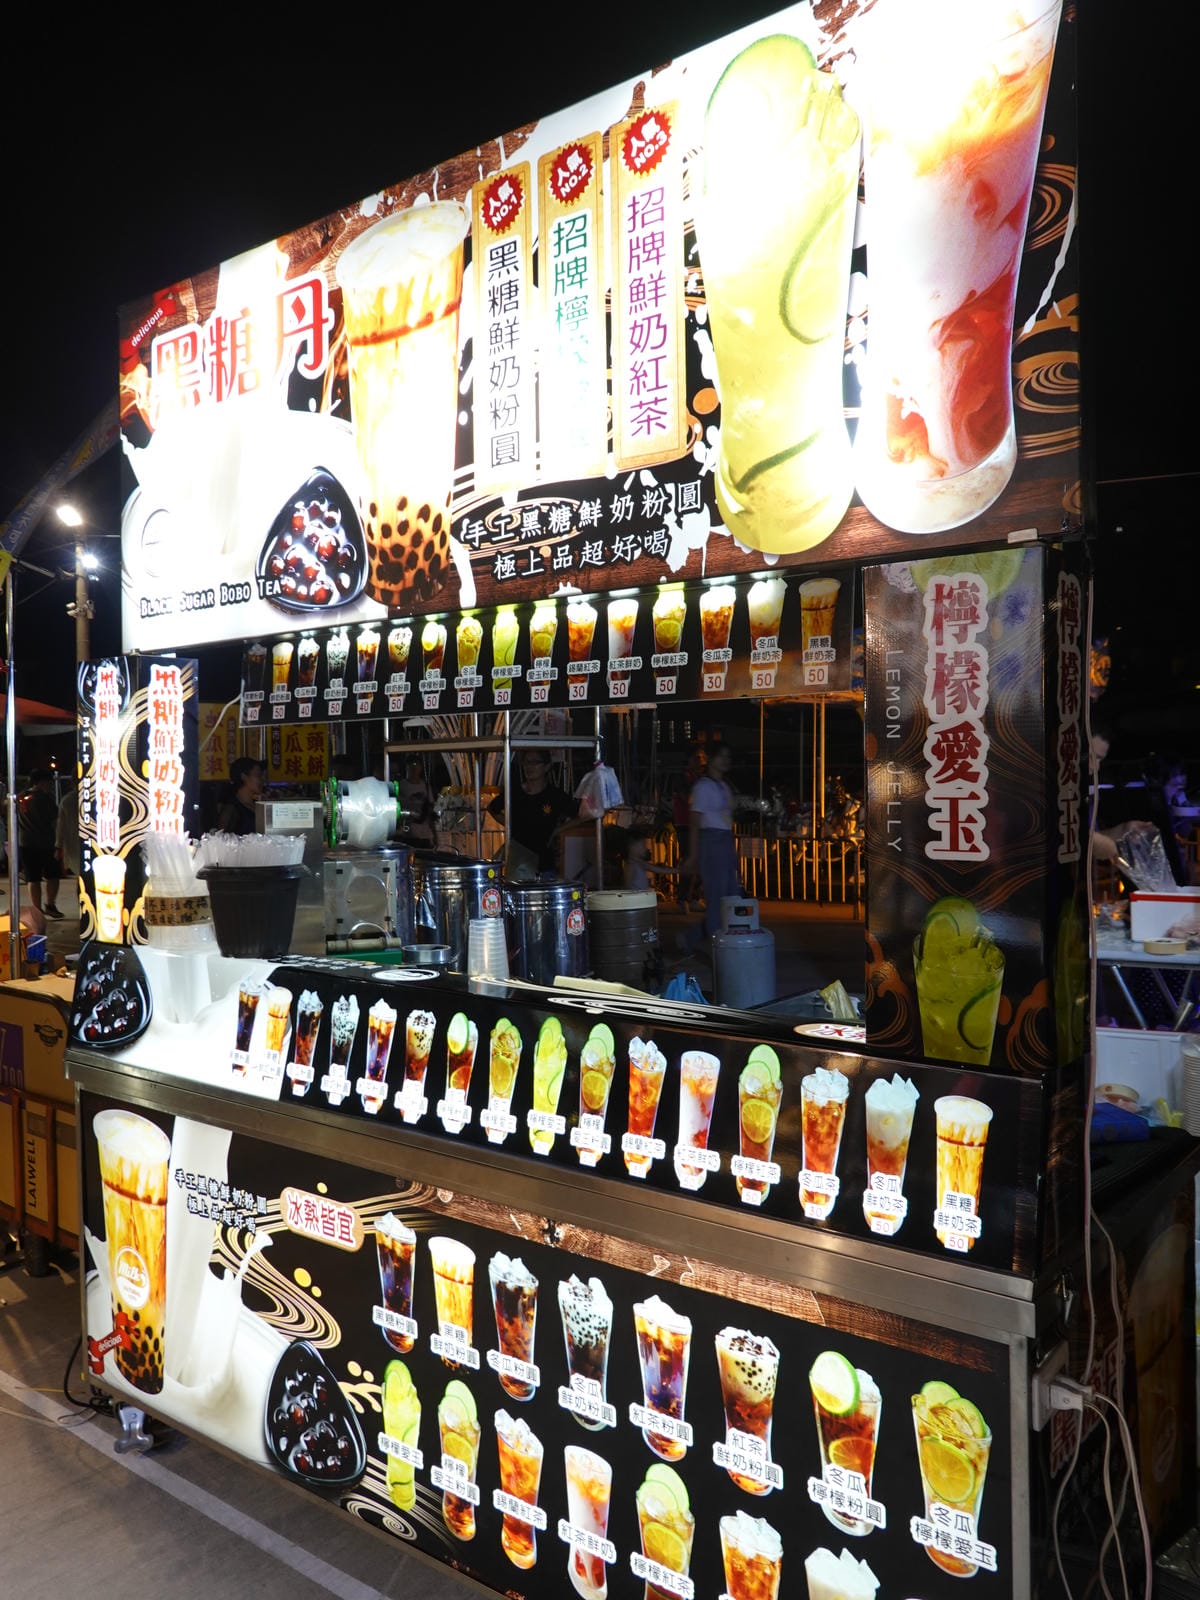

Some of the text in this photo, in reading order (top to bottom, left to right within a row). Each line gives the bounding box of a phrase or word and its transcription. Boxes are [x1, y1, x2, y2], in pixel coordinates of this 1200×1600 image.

[634, 131, 668, 169] NO.3
[560, 163, 590, 197] NO.2
[491, 195, 519, 226] NO.1
[627, 186, 668, 437] 招牌鮮奶紅茶
[130, 307, 164, 347] delicious
[487, 240, 521, 469] 黑糖鮮奶粉圓
[462, 480, 701, 548] 手工黑糖鮮奶粉圓
[493, 527, 671, 582] 極上品超好喝
[178, 589, 215, 613] SUGAR
[220, 583, 252, 604] BOBO
[258, 577, 282, 599] TEA
[758, 637, 776, 648] 冬瓜
[810, 637, 831, 648] 黑糖
[703, 649, 731, 660] 冬瓜茶
[752, 650, 782, 662] 鮮奶茶
[804, 650, 835, 663] 鮮奶茶
[756, 673, 772, 686] 50
[808, 669, 825, 682] 50
[613, 683, 626, 695] 50
[659, 680, 674, 692] 50
[707, 676, 722, 689] 30
[497, 691, 509, 703] 50
[534, 688, 546, 700] 50
[573, 686, 585, 698] 30
[391, 698, 402, 710] 50
[426, 695, 437, 707] 50
[460, 694, 472, 705] 50
[274, 707, 284, 718] 50
[300, 705, 310, 716] 40
[330, 702, 340, 713] 50
[359, 701, 369, 712] 40
[930, 580, 982, 854] 檸檬愛玉
[885, 650, 905, 852] LEMON JELLY
[28, 1138, 37, 1208] LAIWELL
[287, 1193, 356, 1244] 冰熱皆宜
[875, 1220, 891, 1233] 50
[949, 1237, 965, 1250] 50
[574, 1376, 600, 1398] 冬瓜
[631, 1407, 691, 1442] 紅茶粉圓
[731, 1432, 763, 1456] 紅茶
[715, 1447, 780, 1485] 鮮奶粉圓
[829, 1466, 864, 1493] 冬瓜
[811, 1482, 882, 1523] 檸檬粉圓
[934, 1505, 973, 1536] 冬瓜
[914, 1521, 994, 1568] 檸檬愛玉
